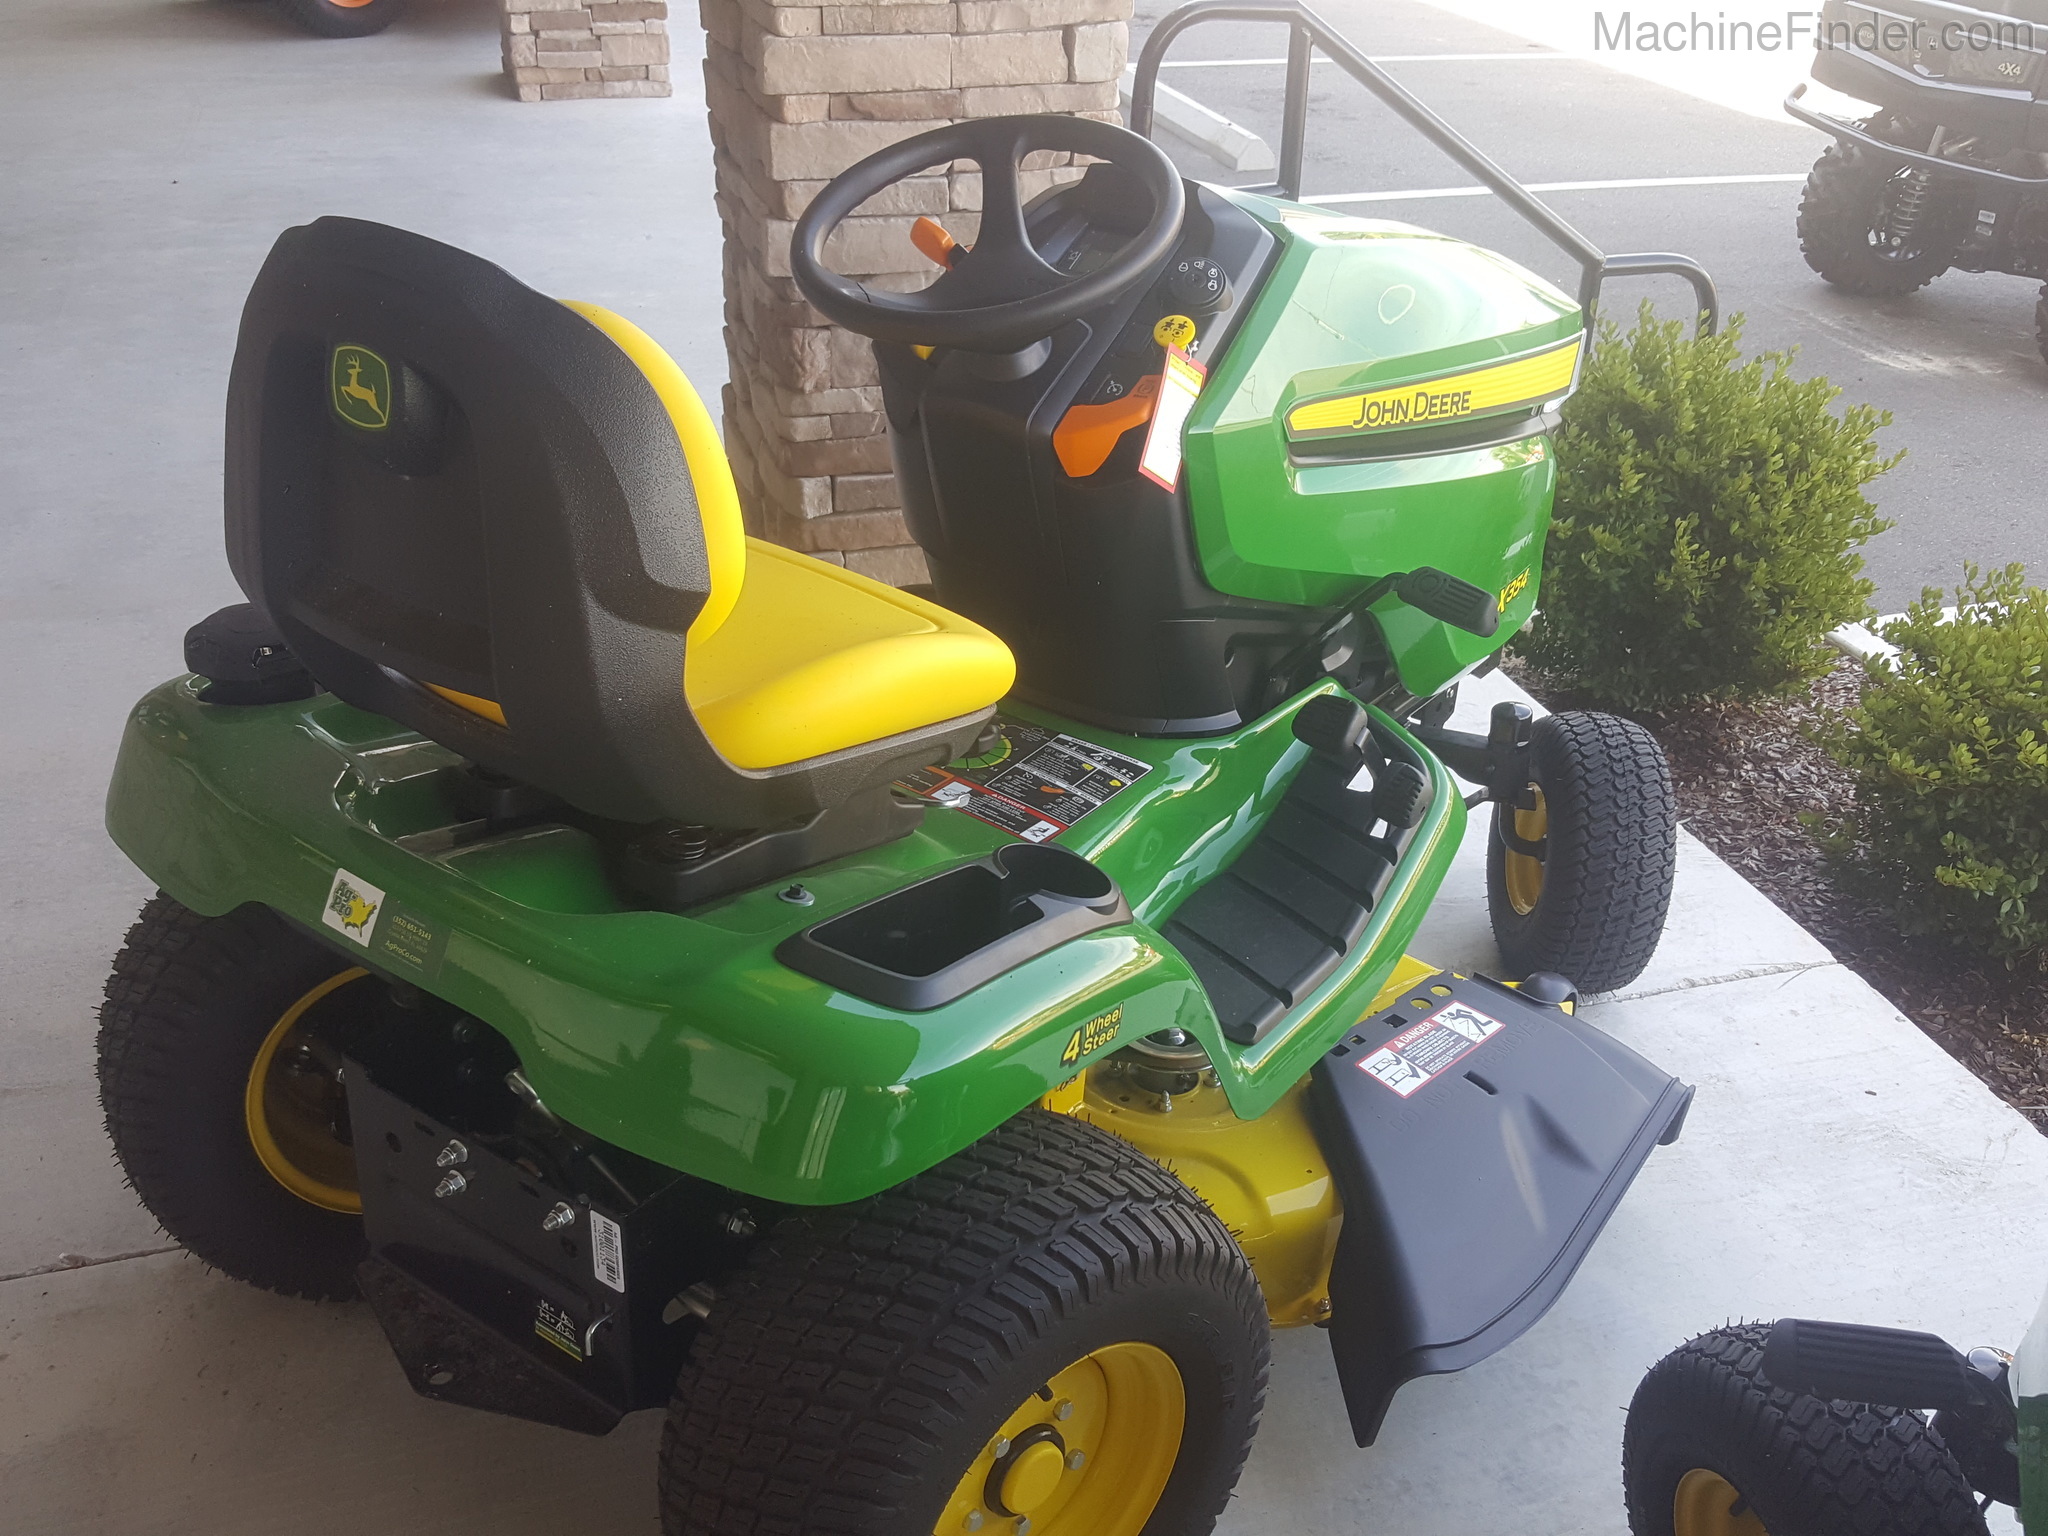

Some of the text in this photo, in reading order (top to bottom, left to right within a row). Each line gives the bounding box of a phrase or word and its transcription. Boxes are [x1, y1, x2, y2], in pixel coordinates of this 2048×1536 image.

[1353, 391, 1472, 426] JOHN DEERE
[1497, 568, 1530, 613] X354
[997, 795, 1027, 810] DANGER
[329, 895, 353, 918] Pro
[385, 940, 423, 965] AgProCo.com
[1086, 1002, 1124, 1038] Wheel
[1399, 1021, 1434, 1043] DANGER
[1062, 1030, 1081, 1062] 4
[1082, 1023, 1120, 1056] Steer
